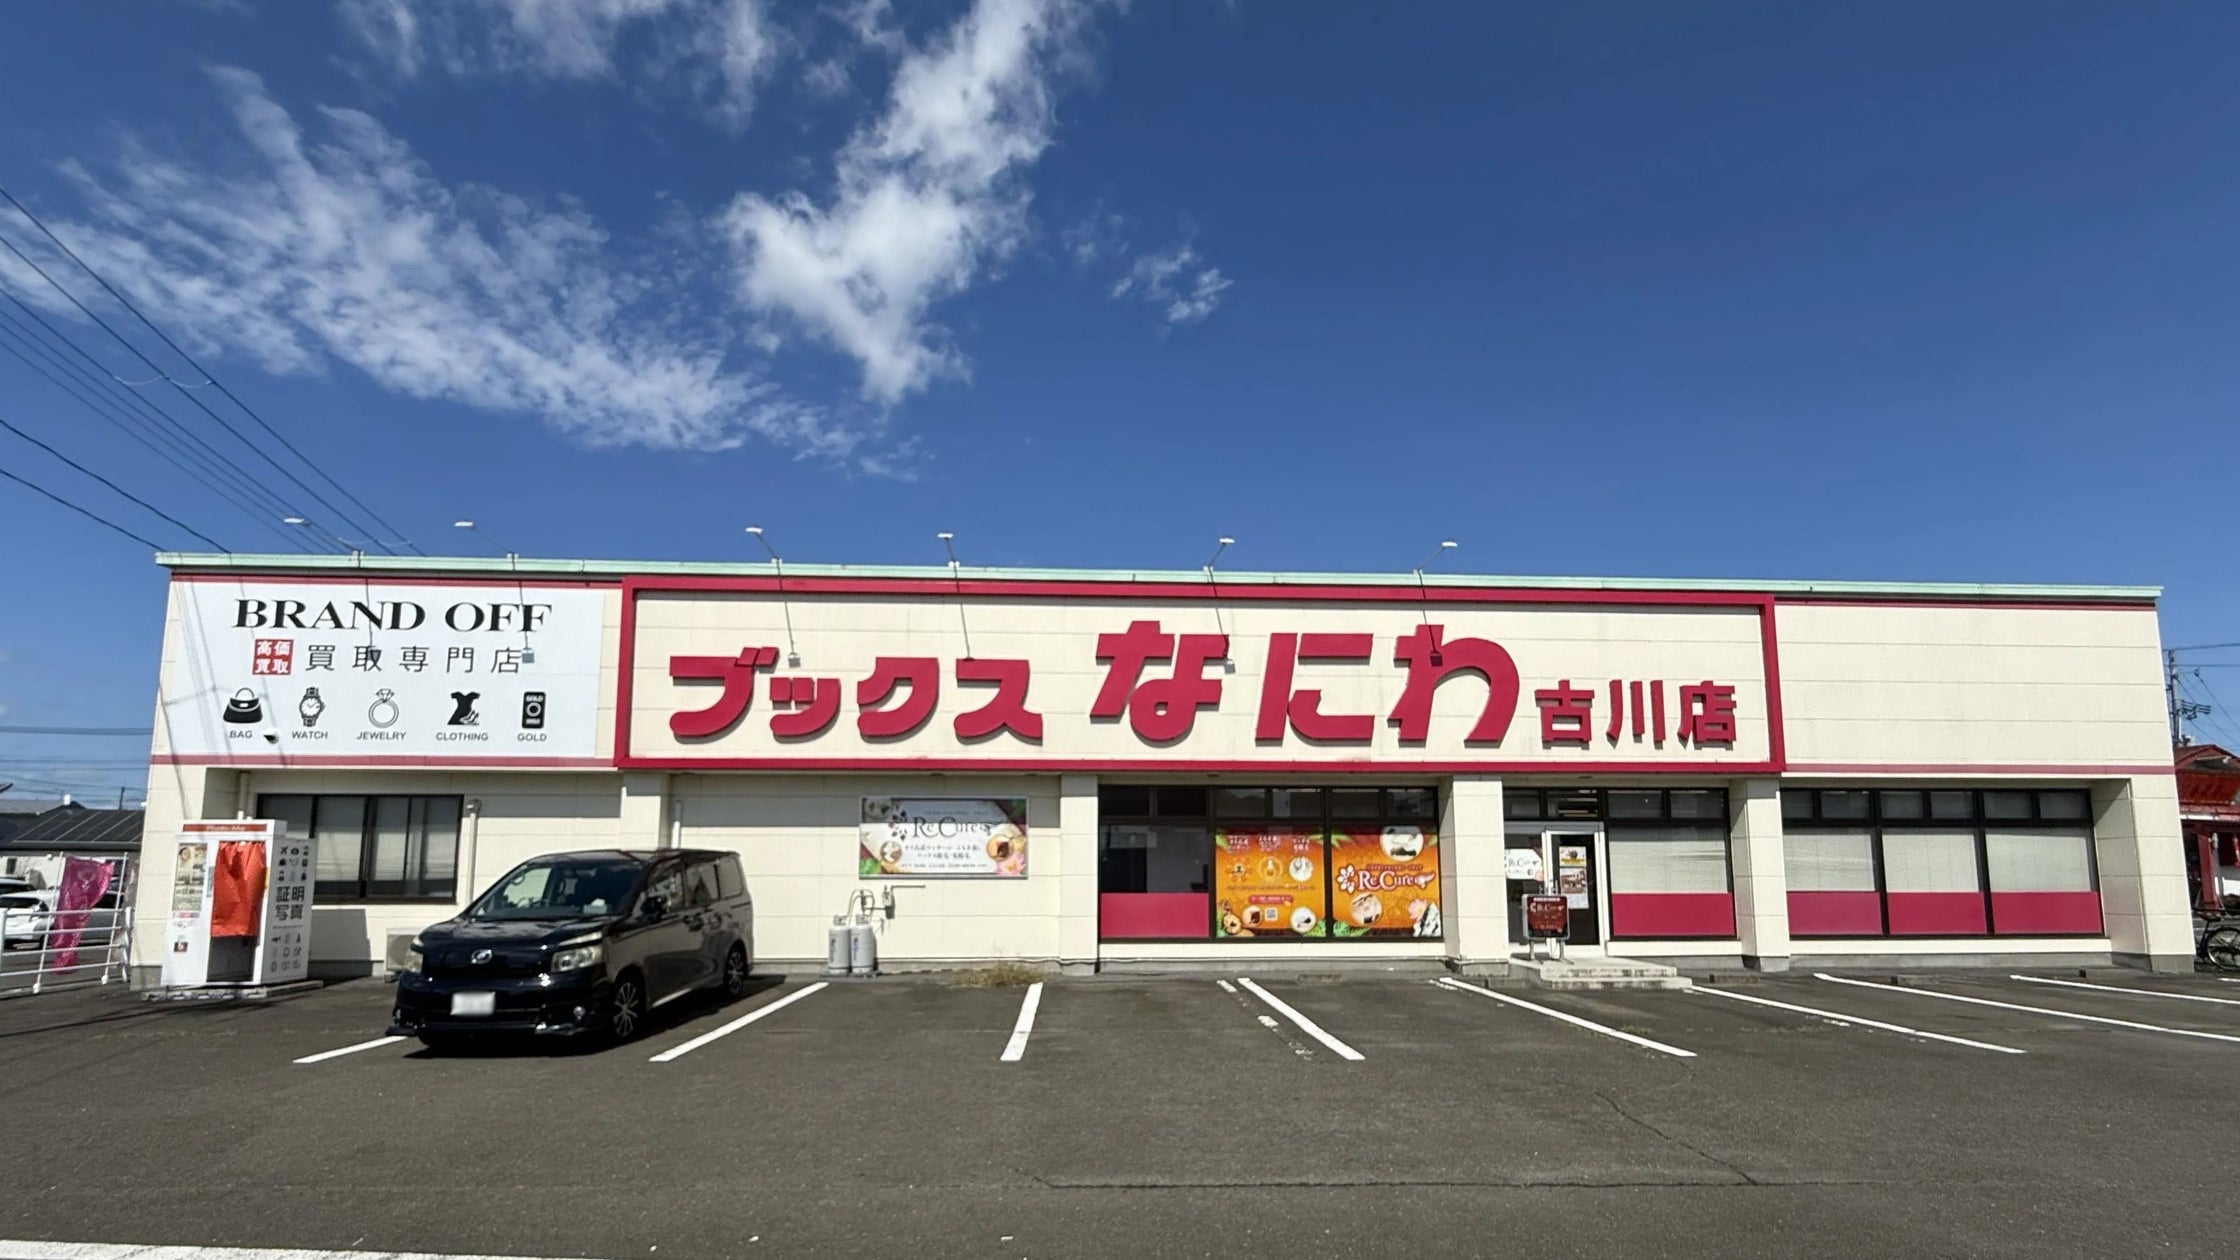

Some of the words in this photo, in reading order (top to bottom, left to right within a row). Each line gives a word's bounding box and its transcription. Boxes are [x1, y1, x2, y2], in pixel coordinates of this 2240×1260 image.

[231, 598, 425, 631] BRAND
[444, 600, 553, 633] OFF
[257, 640, 291, 656] 高価
[254, 658, 290, 674] 買取
[305, 644, 521, 674] 買取専門店
[669, 647, 1043, 742] ブックス
[1089, 620, 1520, 744] なにわ
[1534, 679, 1737, 745] 古川店
[229, 729, 253, 739] BAG
[291, 730, 329, 740] WATCH
[356, 731, 407, 741] JEWELRY
[435, 731, 489, 742] CLOTHING
[517, 732, 548, 742] GOLD
[276, 886, 305, 903] 証明
[275, 903, 303, 921] 写真
